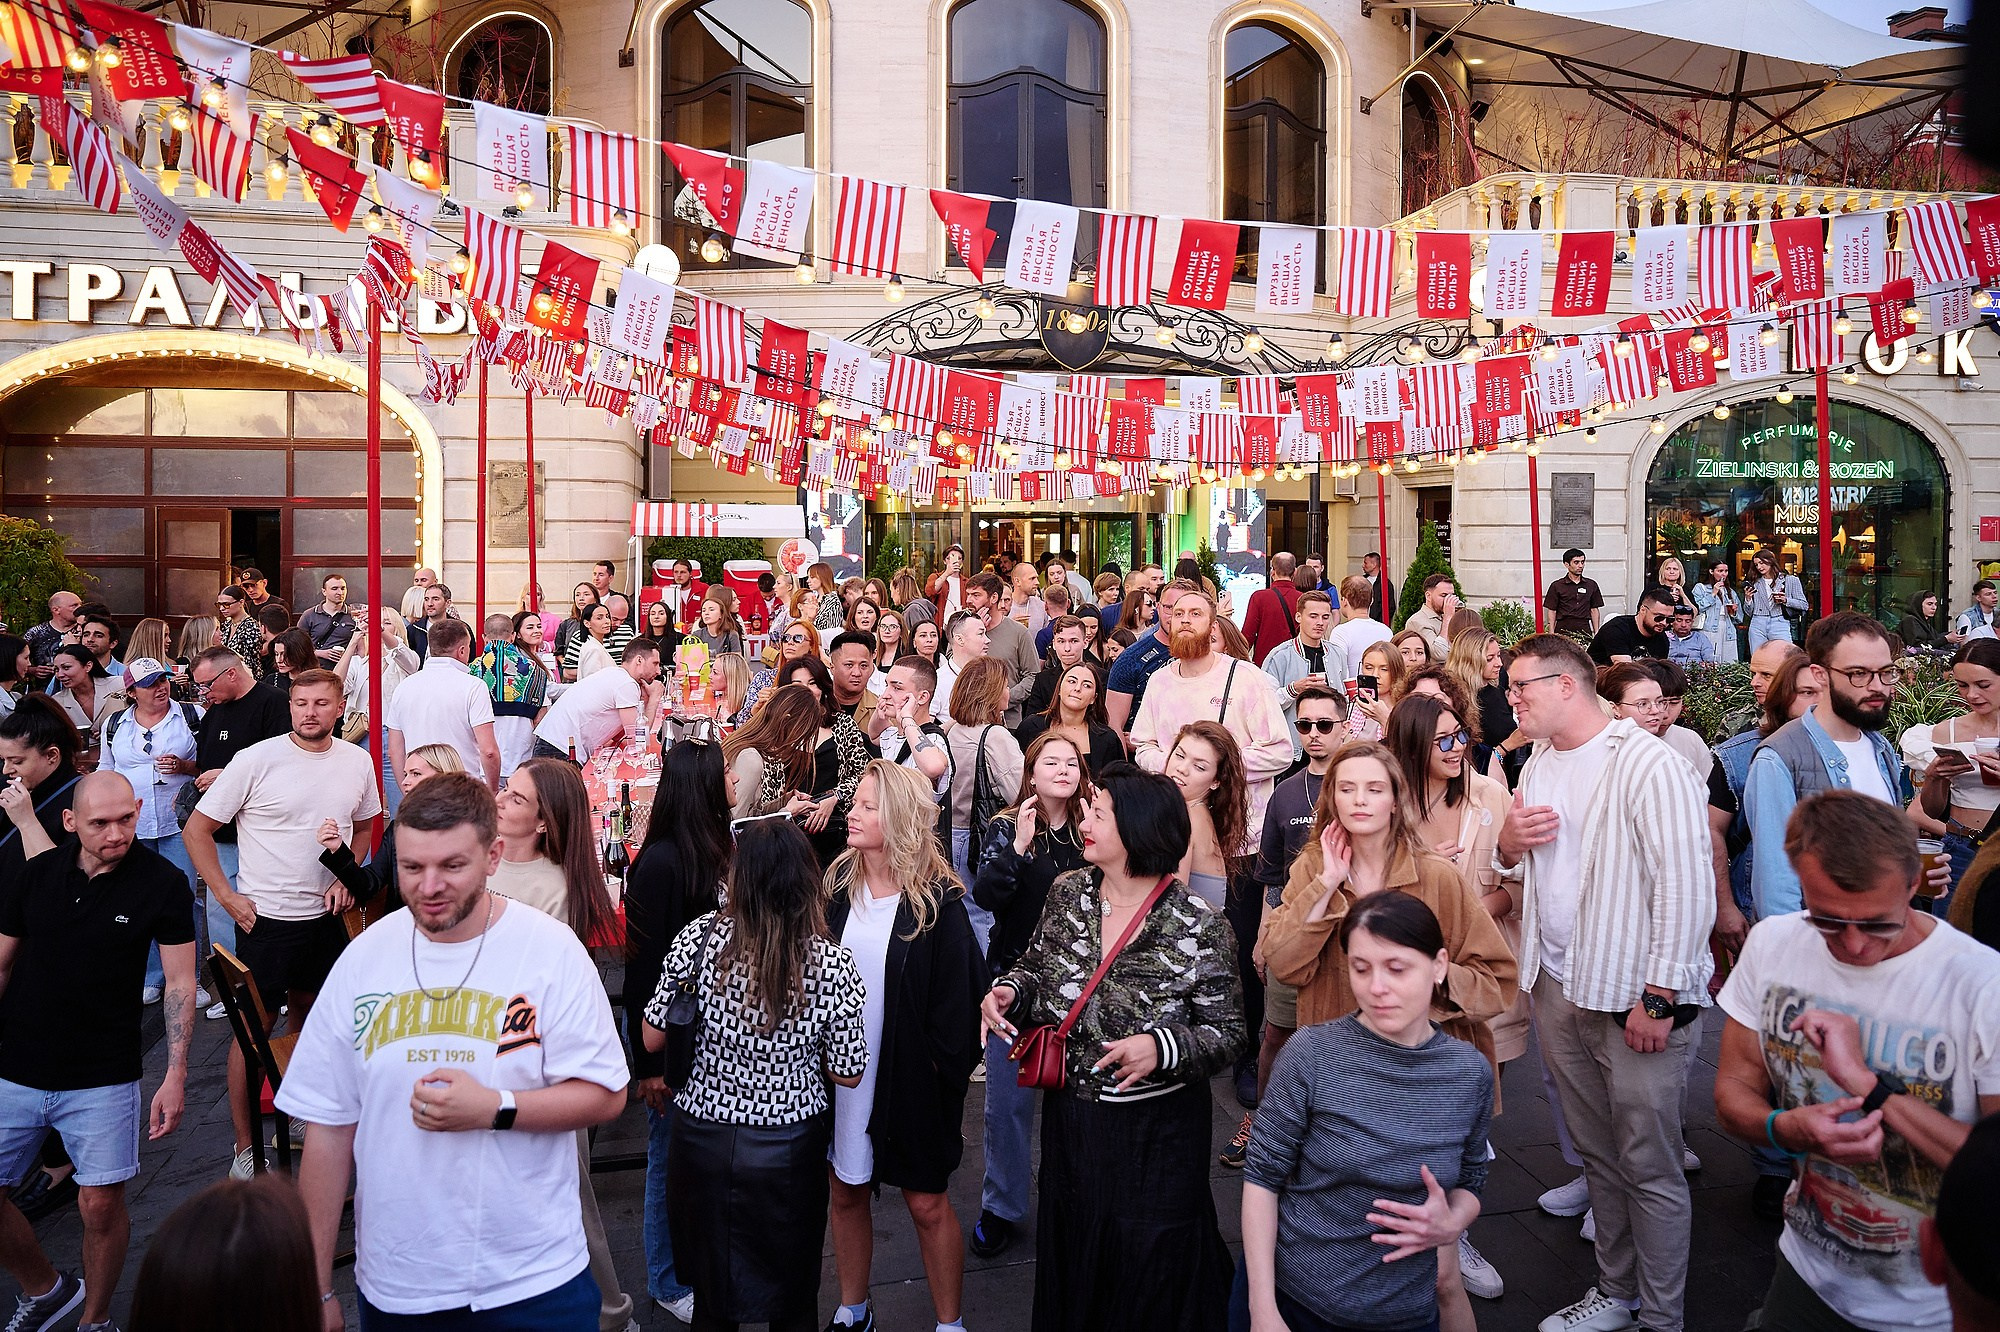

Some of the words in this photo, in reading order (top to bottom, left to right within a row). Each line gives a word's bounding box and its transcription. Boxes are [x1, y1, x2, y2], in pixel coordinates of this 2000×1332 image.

[124, 28, 156, 87] ЛУЧШИЙ
[140, 30, 168, 86] ФИЛЬТР
[493, 142, 504, 192] ДРУЗЬЯ
[506, 134, 517, 193] ВЫСШАЯ
[520, 123, 531, 183] ННОСТЬ
[128, 182, 177, 225] ЦЕННОСТ
[133, 198, 173, 232] ВЫСША
[751, 201, 769, 248] ДРУЗЬЯ
[763, 195, 783, 250] ВЫСШАЯ
[776, 185, 799, 253] ЦЕННОСТЬ
[1020, 236, 1034, 281] ДРУЗЬЯ
[1031, 230, 1048, 283] ВЫСШАЯ
[1043, 221, 1061, 286] ЦЕННОСТЬ
[1798, 245, 1810, 291] ЛУЧШИЙ
[1807, 246, 1817, 290] ФИЛЬТР
[1843, 244, 1851, 285] ДРУЗЬЯ
[1852, 237, 1860, 284] ВЫСШАЯ
[1862, 226, 1870, 284] ЦЕННОСТЬ
[1979, 226, 1995, 268] СОЛНЦЕ
[1181, 251, 1200, 299] СОЛНЦЕ
[1192, 249, 1211, 301] ЛУЧШИЙ
[1204, 254, 1221, 302] ФИЛЬТР
[1270, 263, 1280, 306] ДРУЗЬЯ
[1281, 255, 1291, 306] ВЫСШАЯ
[1292, 242, 1302, 305] ЦЕННОСТЬ
[1428, 262, 1437, 310] СОЛНЦЕ
[1437, 261, 1448, 310] ЛУЧШИЙ
[1448, 263, 1458, 310] ФИЛЬТР
[1496, 269, 1506, 311] ДРУЗЬЯ
[1507, 261, 1518, 310] ВЫСШАЯ
[1518, 249, 1529, 310] ЦЕННОСТЬ
[1563, 262, 1578, 309] СОЛНЦЕ
[1574, 260, 1588, 308] ЛУЧШИЙ
[1585, 262, 1598, 307] ФИЛЬТР
[1645, 262, 1653, 303] ДРУЗЬЯ
[1655, 253, 1665, 301] ВЫСШАЯ
[1666, 240, 1675, 300] ЦЕННОСТЬ
[1788, 247, 1800, 293] СОЛНЦЕ
[549, 276, 572, 324] ЛУЧШИЙ
[562, 282, 581, 327] ФИЛЬТР
[1879, 299, 1890, 339] СОЛНЦЕ
[1951, 289, 1959, 324] ВЫСШАЯ
[623, 303, 636, 343] ДРУЗЬЯ
[631, 300, 648, 347] ВЫСШАЯ
[641, 293, 661, 351] ЦЕННОСТЬ
[766, 348, 779, 391] СОНЦЕ
[1676, 350, 1687, 385] СОЛНЦЕ
[1683, 347, 1696, 383] ЛУЧШИЙ
[1694, 352, 1705, 381] ФИЛЬТ
[1740, 342, 1749, 374] ДРУЗЬЯ
[1749, 335, 1758, 372] ВЫСШАЯ
[699, 382, 708, 409] СОЛНЦЕ
[1365, 386, 1373, 416] ДРУЗЬЯ
[1380, 371, 1389, 415] ЦЕННОСТЬ
[1486, 379, 1494, 413] СОЛНЦЕ
[1494, 376, 1502, 412] ЛУЧШИЙ
[1503, 377, 1511, 411] ФИЛЬТР
[1549, 375, 1557, 406] ДРУЗЬЯ
[1557, 368, 1566, 405] ВЫСШАЯ
[1565, 358, 1575, 403] ЦЕННОСТЬ
[950, 395, 961, 435] СОЛНЦЕ
[958, 395, 969, 437] ЛУЧШИЙ
[967, 399, 977, 438] ФИЛЬТР
[1005, 410, 1015, 441] РУЗЬЯ
[1306, 395, 1315, 427] СОЛНЦЕ
[1314, 393, 1323, 428] ЛУЧШИЙ
[1322, 395, 1330, 427] ФИЛЬТР
[1114, 416, 1124, 455] СОЛНЦЕ
[1122, 416, 1131, 455] ЛУЧШИЙ
[1288, 437, 1297, 462] РУЗЬЯ
[1741, 424, 1856, 453] PERFUMRIE
[1697, 459, 1799, 479] ZIELINSKI
[1828, 460, 1895, 479] ROZEN
[1775, 526, 1819, 535] FLOWERS
[406, 1049, 441, 1063] EST
[445, 1050, 476, 1063] 1978
